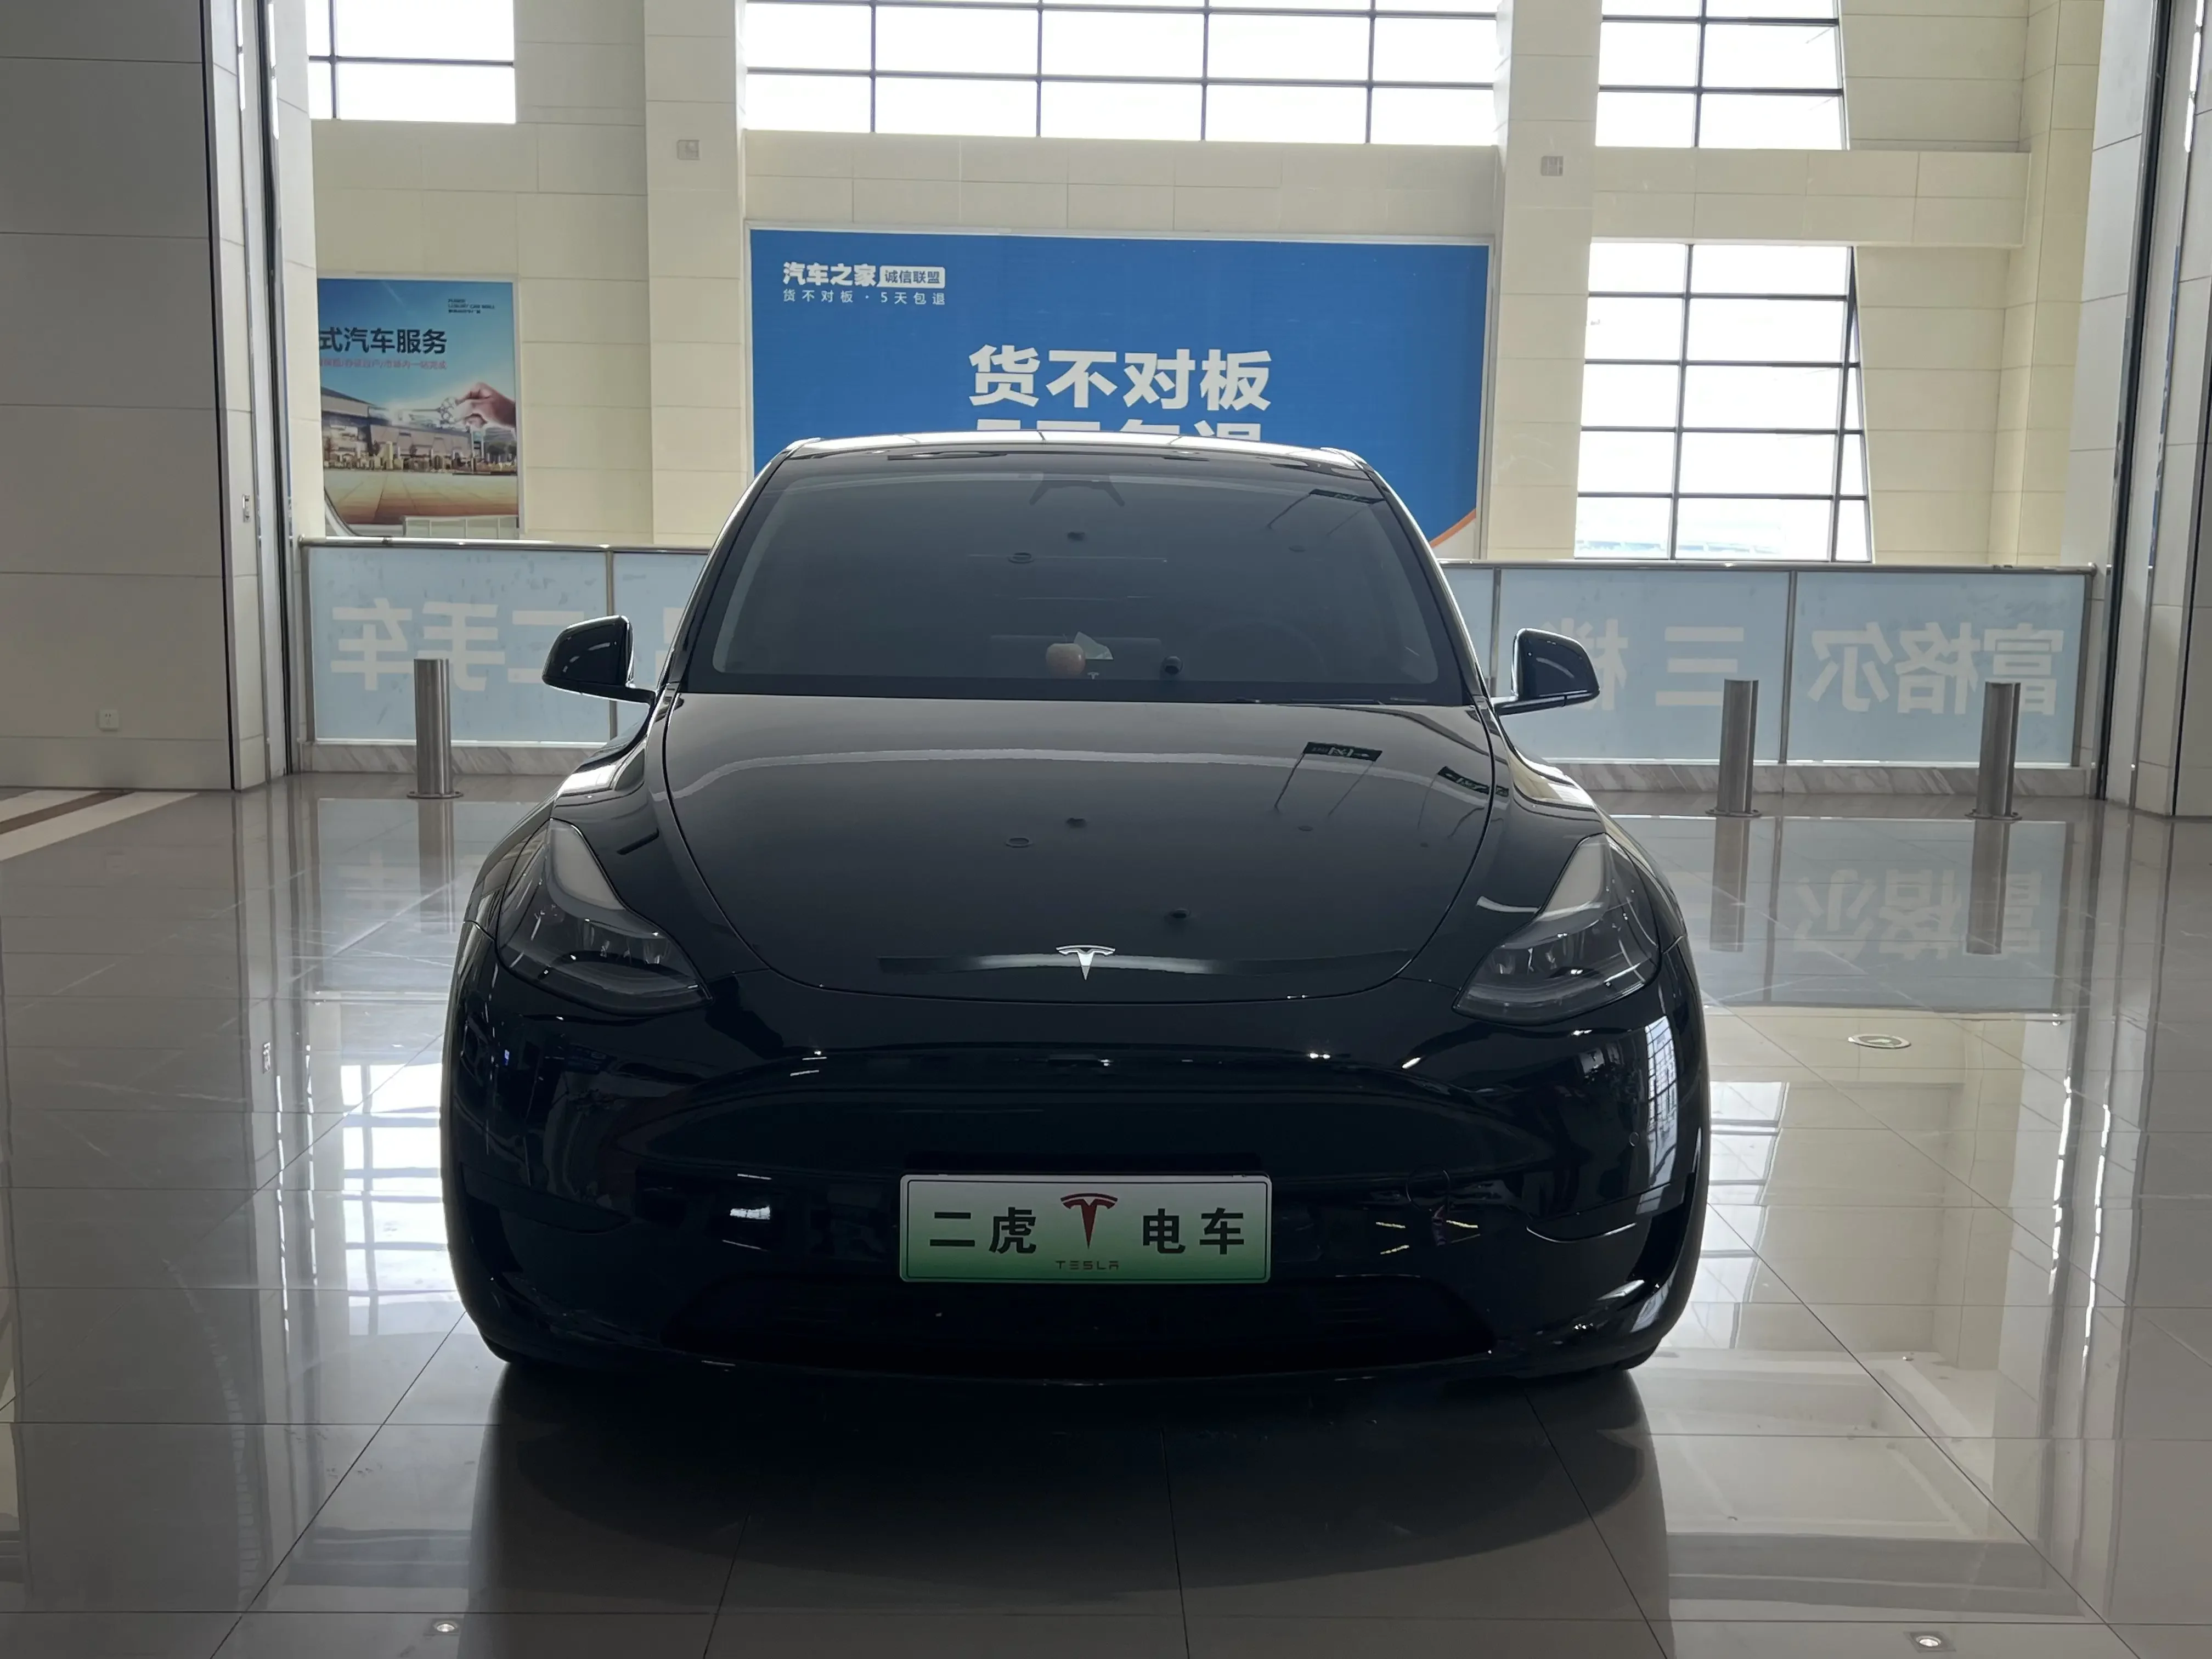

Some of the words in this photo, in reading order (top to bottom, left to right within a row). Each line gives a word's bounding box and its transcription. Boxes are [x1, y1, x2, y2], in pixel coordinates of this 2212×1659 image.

[783, 262, 876, 286] 汽车之家
[884, 269, 941, 284] 诚信联盟
[319, 326, 447, 354] 式汽车服务
[968, 344, 1273, 411] 货不对板
[929, 1207, 1037, 1254] 二虎
[1142, 1207, 1245, 1255] 电车
[1055, 1260, 1119, 1271] TESLA
